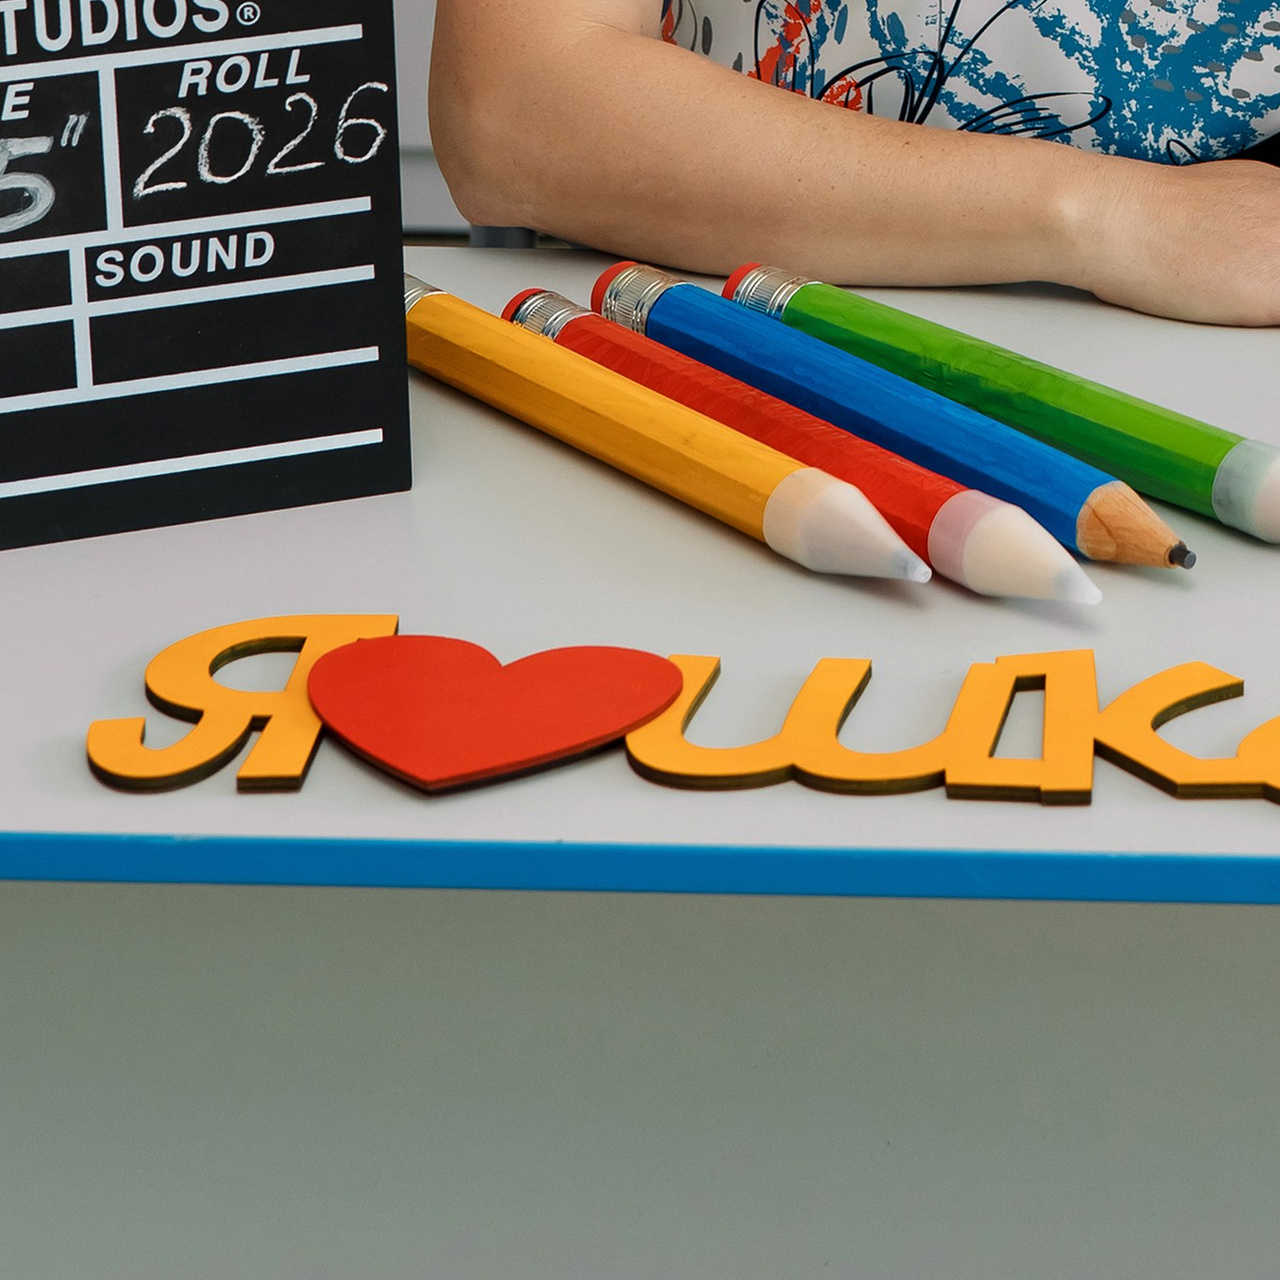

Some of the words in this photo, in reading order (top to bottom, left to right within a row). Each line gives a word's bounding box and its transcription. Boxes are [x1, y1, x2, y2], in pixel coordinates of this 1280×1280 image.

[178, 48, 312, 99] ROLL
[133, 81, 389, 199] 2026
[95, 230, 275, 288] SOUND
[87, 613, 399, 793] Я
